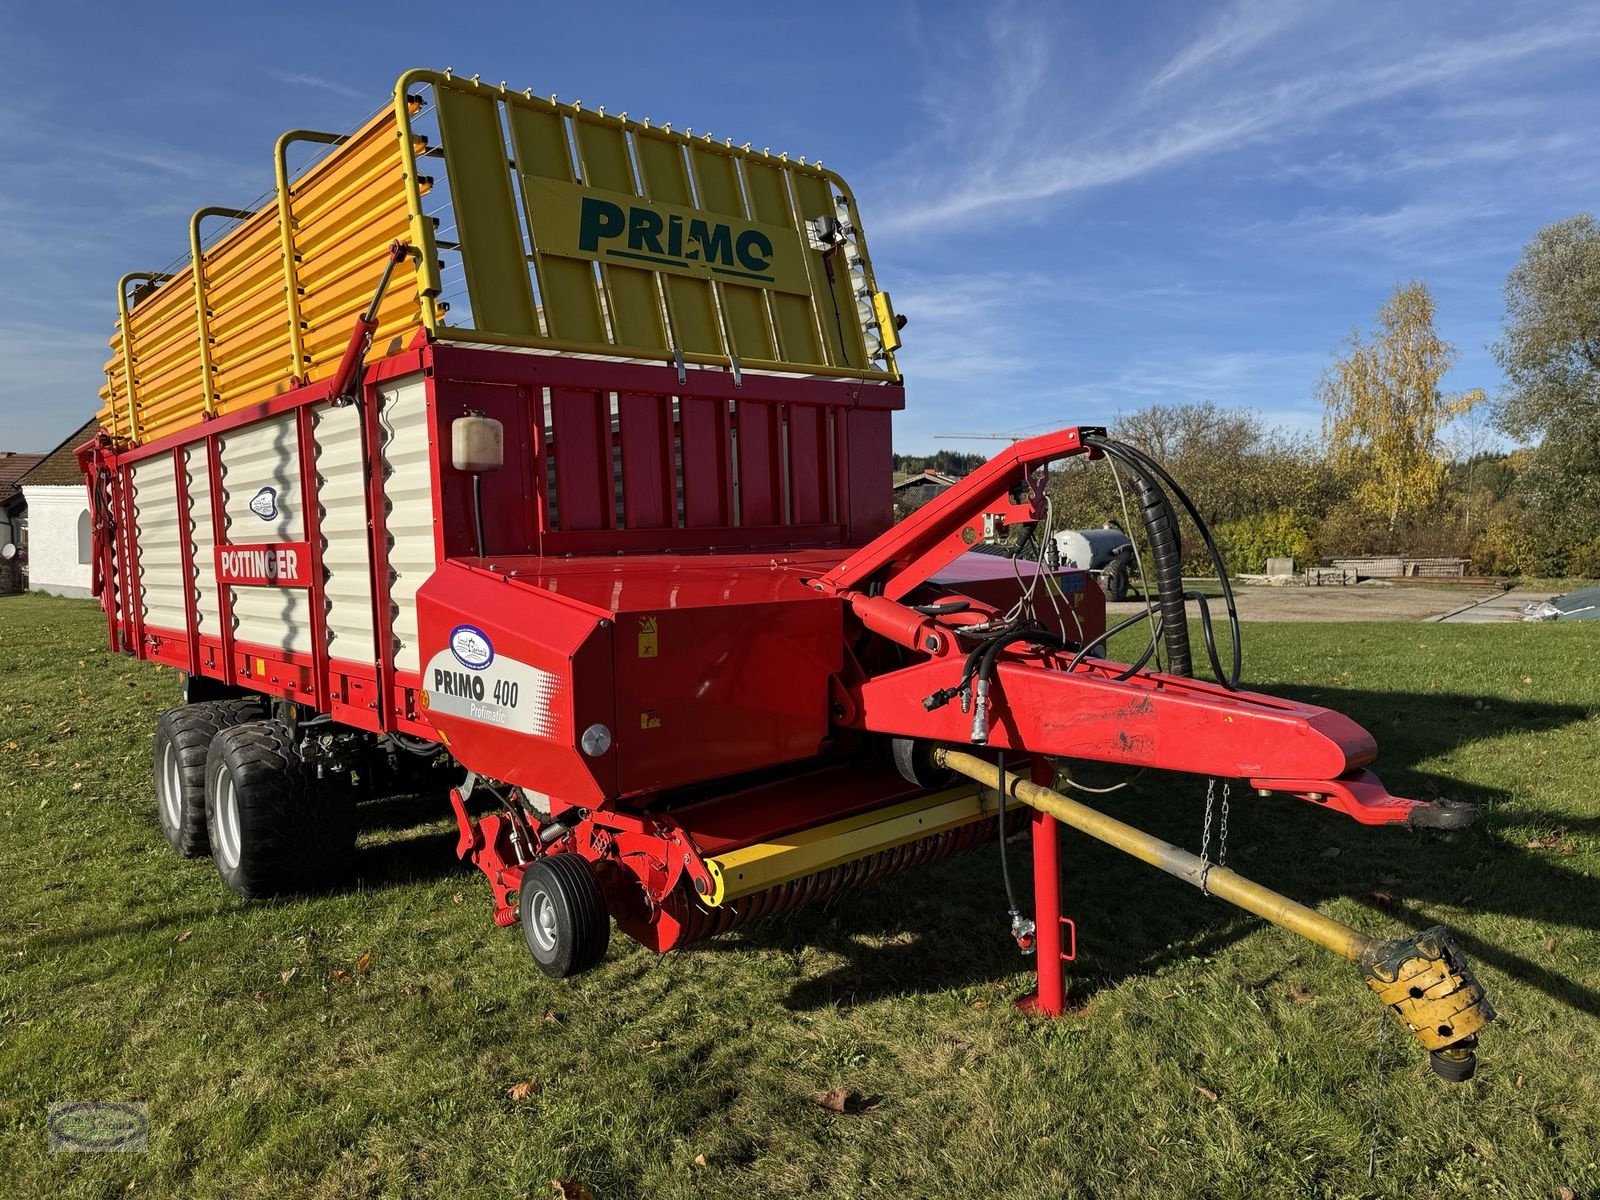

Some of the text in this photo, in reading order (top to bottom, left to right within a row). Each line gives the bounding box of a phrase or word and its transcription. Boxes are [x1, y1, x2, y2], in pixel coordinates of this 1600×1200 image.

[221, 549, 298, 579] PÖTTINGER
[434, 668, 519, 708] PRIMO 400
[470, 703, 505, 723] Profimatic
